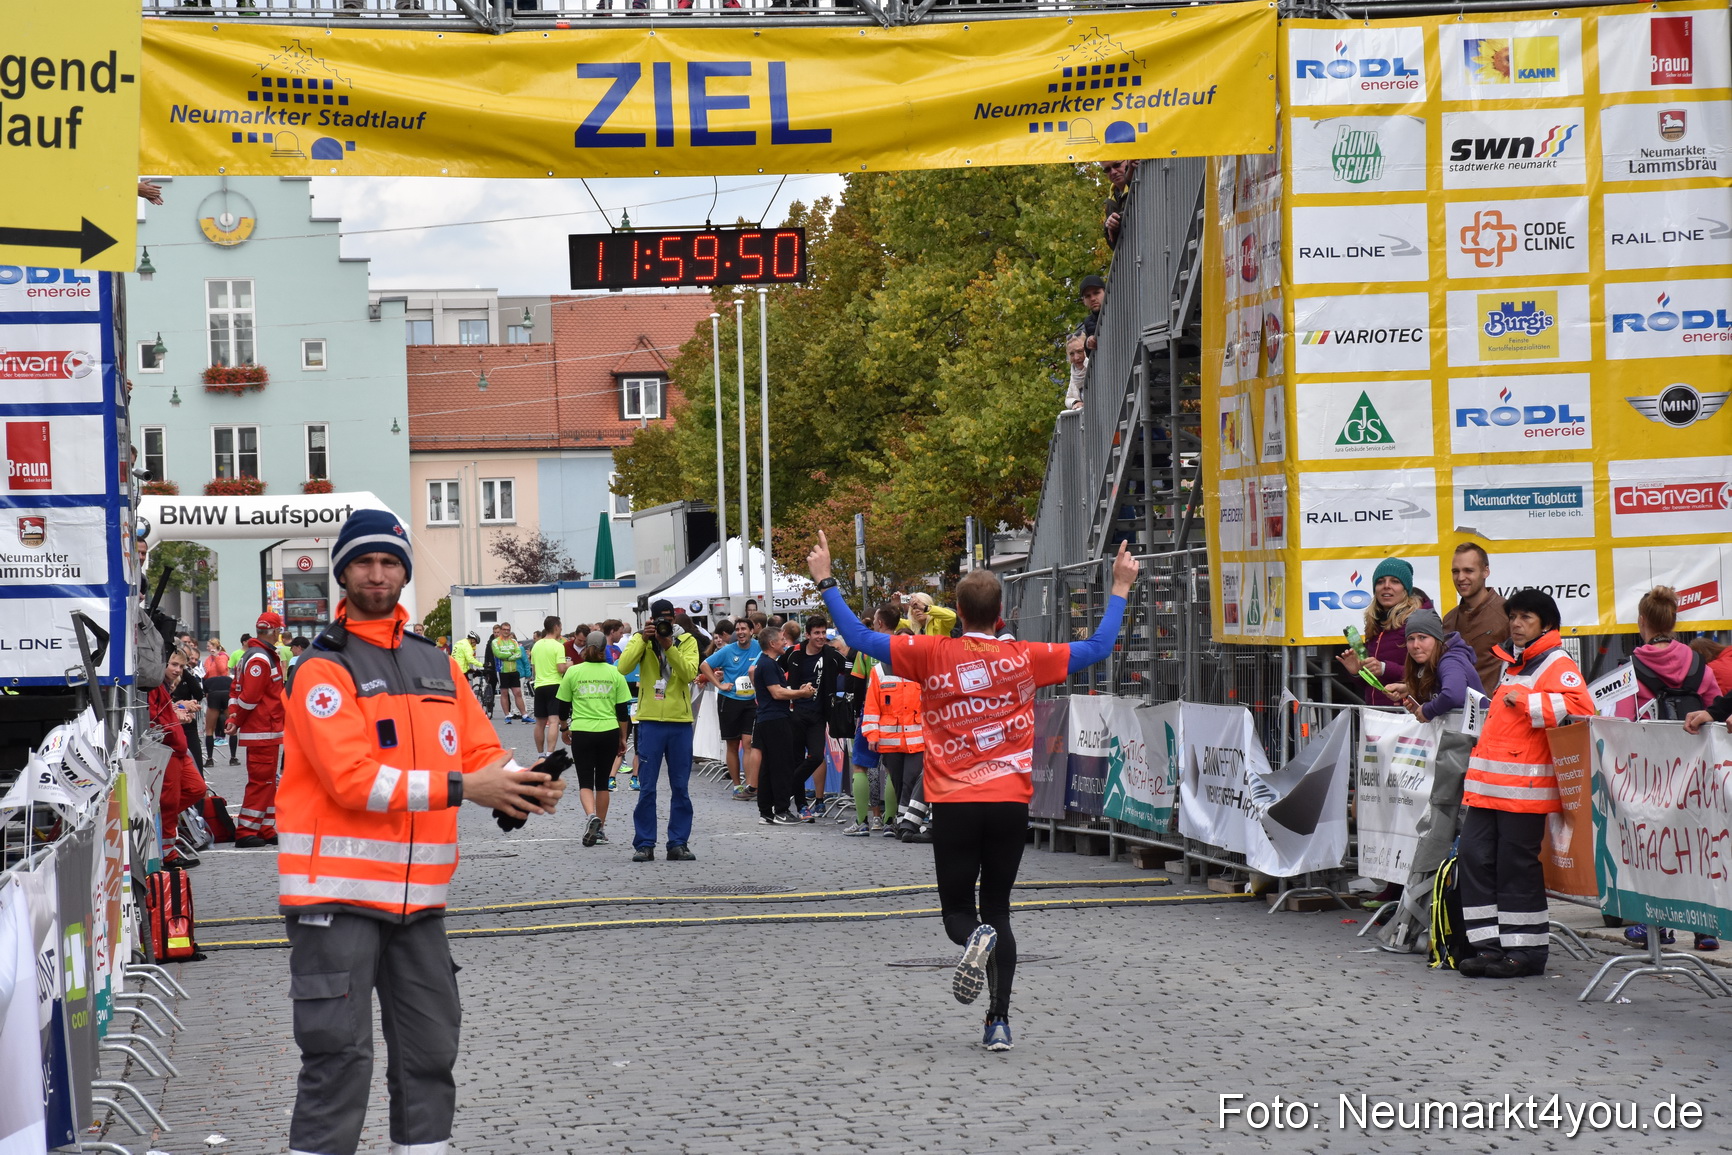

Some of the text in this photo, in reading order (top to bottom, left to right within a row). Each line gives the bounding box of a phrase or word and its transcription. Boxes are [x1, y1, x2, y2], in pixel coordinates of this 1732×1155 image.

[1651, 55, 1689, 72] Braun
[0, 50, 134, 99] gend-
[1518, 67, 1556, 79] KANN
[1361, 76, 1418, 91] energie
[575, 61, 832, 148] ZIEL
[974, 85, 1217, 120] Neumarkter Stadtlauf
[170, 104, 427, 130] Neumarkter Stadtlauf
[1336, 125, 1378, 154] RUND
[1450, 137, 1534, 162] swn
[1641, 145, 1706, 158] Neumarkter
[1333, 155, 1386, 181] SCHAU
[1449, 160, 1557, 173] stadtwerke neumarkt
[1629, 157, 1717, 173] Lammsbräu
[1524, 222, 1566, 236] CODE
[1611, 229, 1704, 245] RAIL.ONE
[1524, 236, 1575, 251] CLINIC
[598, 234, 798, 281] 11:59.50
[1300, 245, 1385, 259] RAIL.ONE
[27, 283, 91, 297] energie
[1485, 311, 1553, 336] Burgis
[1334, 328, 1423, 344] VARIOTEC
[1683, 329, 1732, 342] energi
[1663, 399, 1697, 412] MINI
[1524, 421, 1585, 438] energie
[8, 460, 48, 477] Braun
[1469, 490, 1577, 507] Neumarkter Tagblatt
[1620, 487, 1713, 507] charivari
[160, 504, 353, 527] BMW Laufsport
[1307, 509, 1393, 523] RAIL.ONE
[1529, 509, 1584, 518] Hier lebe ich.
[0, 553, 68, 563] Neumarkter
[0, 565, 81, 579] mmsbräu
[1498, 584, 1590, 599] VAOTEC
[962, 639, 1000, 652] Team
[588, 684, 613, 694] DAV
[1594, 679, 1622, 699] swn
[921, 691, 1014, 727] raumbox
[956, 717, 982, 727] wohnen
[1553, 754, 1580, 767] Partner
